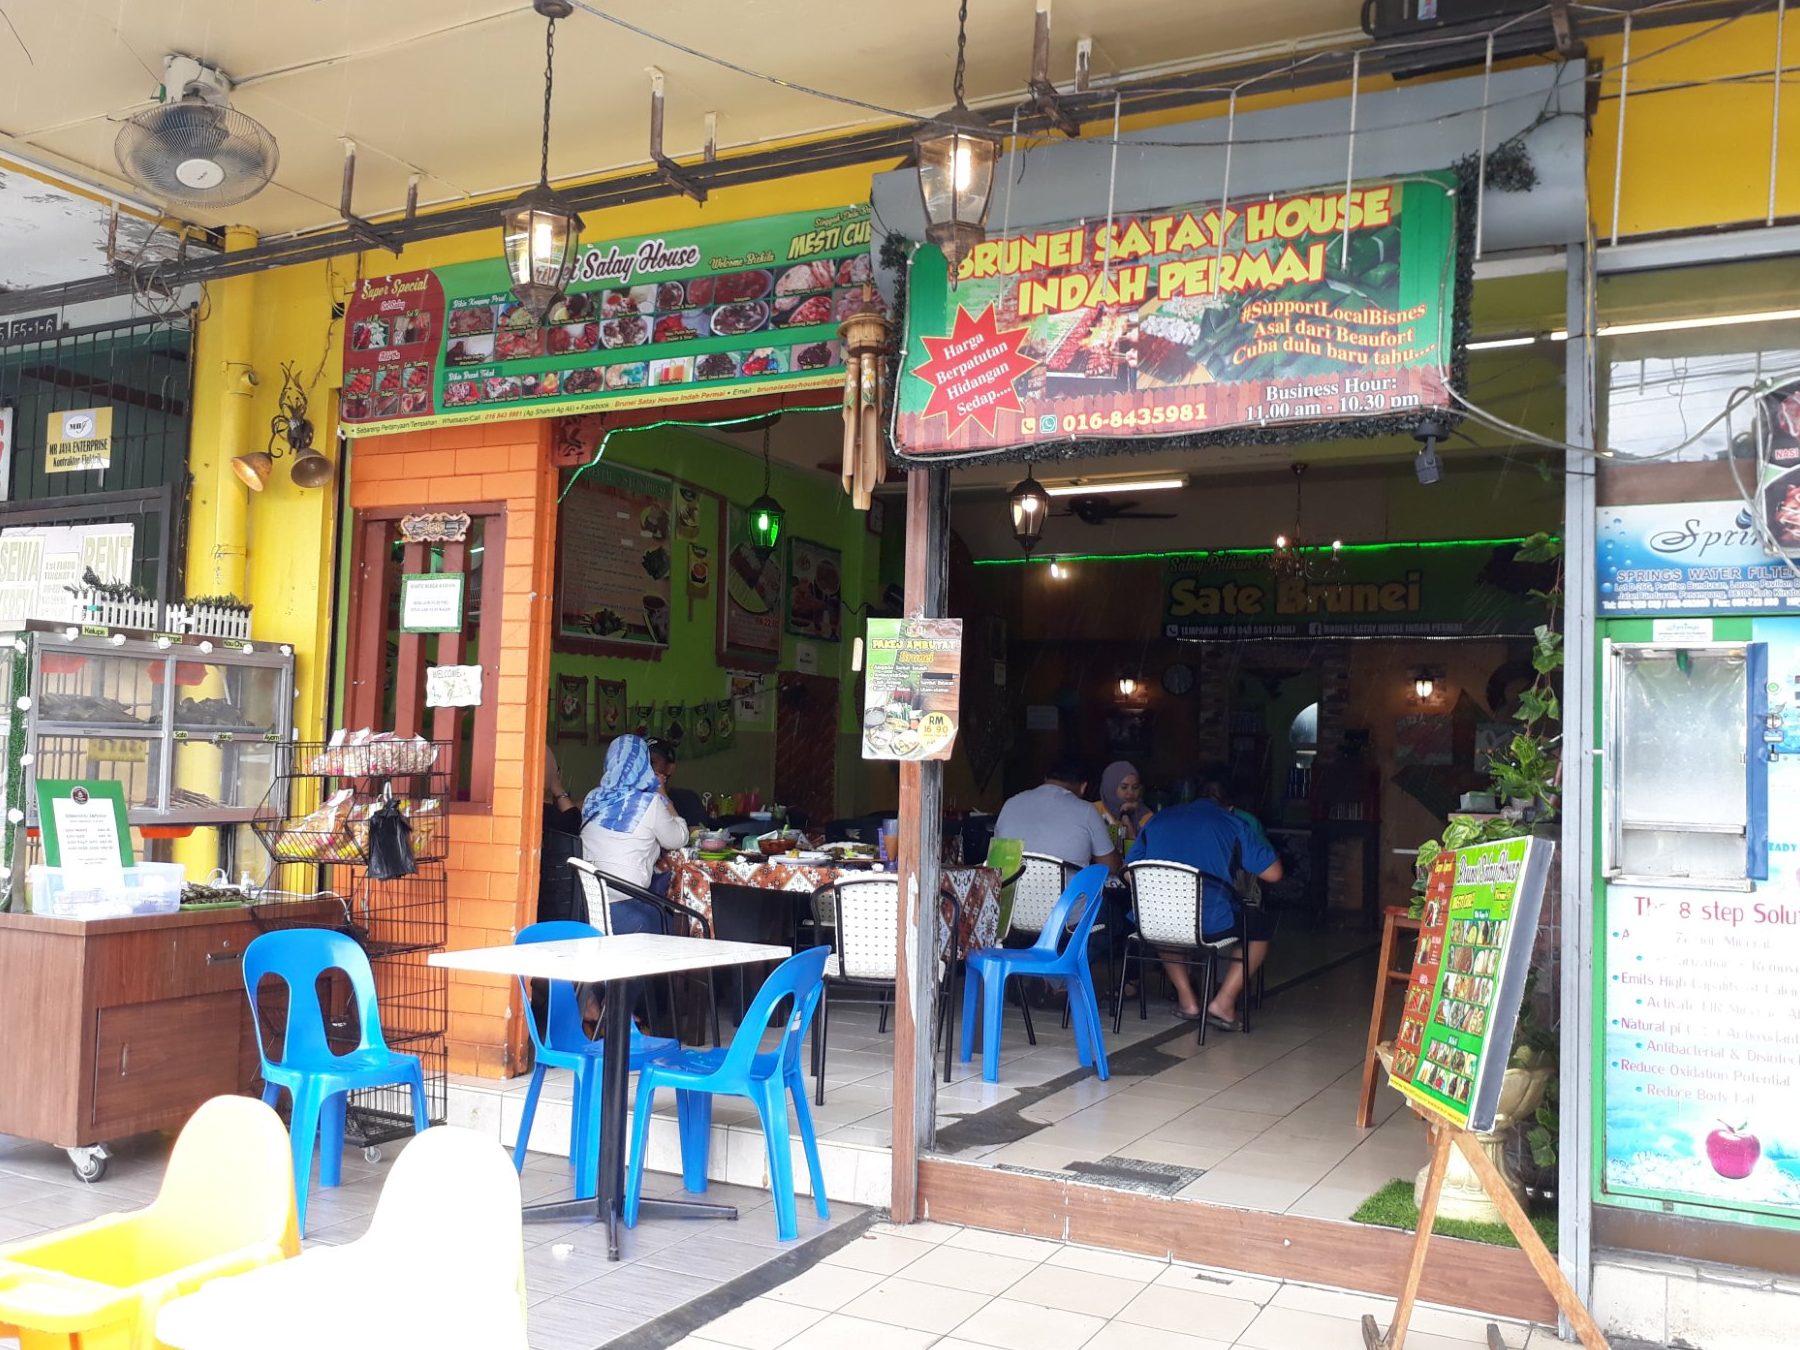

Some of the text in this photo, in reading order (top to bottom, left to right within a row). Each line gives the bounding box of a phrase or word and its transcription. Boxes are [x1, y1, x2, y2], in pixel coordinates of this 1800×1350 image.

[1093, 208, 1239, 262] SATAY
[1246, 186, 1392, 243] HOUSE
[787, 220, 871, 260] MESTI CUB
[583, 248, 635, 282] Satay
[638, 240, 699, 272] House
[391, 273, 429, 297] Special
[1017, 242, 1326, 317] INDAH PERMAI
[1241, 301, 1427, 325] #SupportLocalBisnes
[13, 319, 54, 338] F5-1-6
[1254, 319, 1415, 348] Asal dari Beaufort
[943, 333, 985, 360] Harga
[1233, 338, 1278, 365] Cuba
[1283, 337, 1322, 356] dulu
[1327, 342, 1368, 364] baru
[935, 341, 1008, 386] Berpatutan
[946, 362, 1010, 400] Hidangan
[1266, 377, 1397, 401] Business Hour:
[614, 400, 637, 408] Brunei
[638, 398, 657, 407] Satay
[658, 396, 679, 405] House
[680, 393, 700, 401] Indah
[701, 391, 726, 399] Permai
[732, 387, 752, 396] Email
[1246, 403, 1290, 421] 11.00
[1295, 403, 1321, 416] am
[1340, 394, 1385, 412] 10.30
[1391, 393, 1420, 408] pm
[1062, 403, 1208, 432] 016-8435981
[72, 438, 108, 454] ENTERPRISE
[1775, 449, 1799, 460] NASI
[0, 541, 40, 582] SEWA
[83, 535, 133, 587] RENT
[1616, 568, 1682, 582] SPRINGS
[1688, 567, 1741, 581] WATER
[1168, 569, 1423, 616] Sate Brunei
[907, 639, 955, 650] AMBUYAT
[929, 715, 944, 725] RM
[1768, 842, 1797, 852] EADY
[1679, 901, 1692, 919] 8
[1701, 900, 1744, 928] step
[1621, 972, 1654, 986] Emits
[1621, 1017, 1665, 1032] Natural
[1646, 1040, 1725, 1058] Antibacterial
[1621, 1058, 1665, 1075] Reduce
[1647, 1084, 1692, 1099] Reduce
